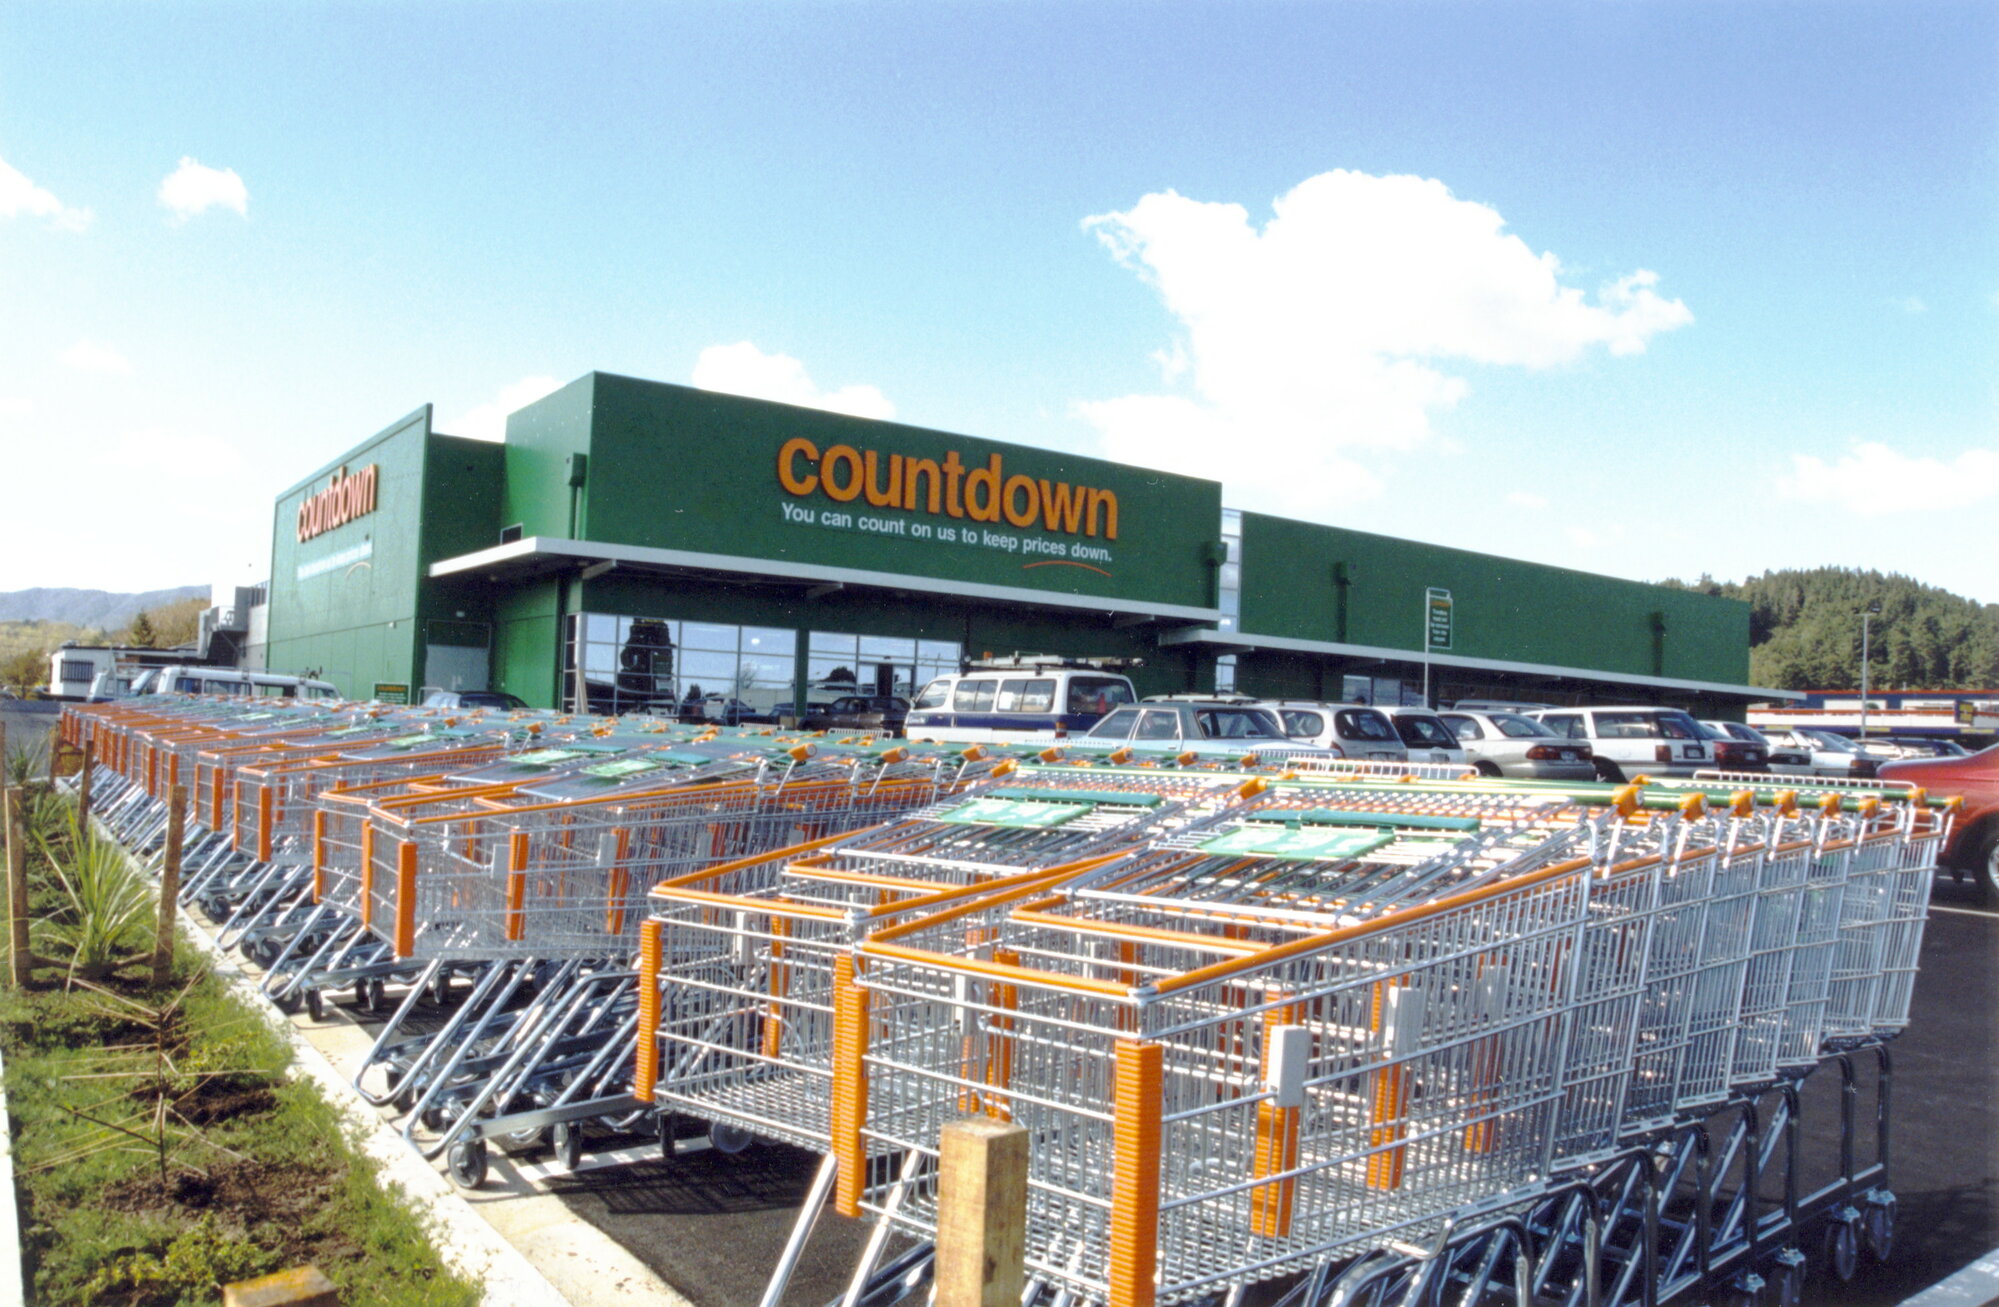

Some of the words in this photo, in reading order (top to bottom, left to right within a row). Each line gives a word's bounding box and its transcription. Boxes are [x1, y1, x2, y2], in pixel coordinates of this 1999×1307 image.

[296, 463, 378, 543] countdown
[778, 437, 1118, 540] countdown
[781, 502, 814, 524] You
[821, 511, 852, 528] can
[858, 516, 905, 535] count
[911, 523, 931, 538] on
[937, 527, 956, 541] us
[962, 528, 978, 544] to
[983, 530, 1018, 552] keep
[1023, 537, 1066, 556] prices
[1071, 542, 1112, 561] down.
